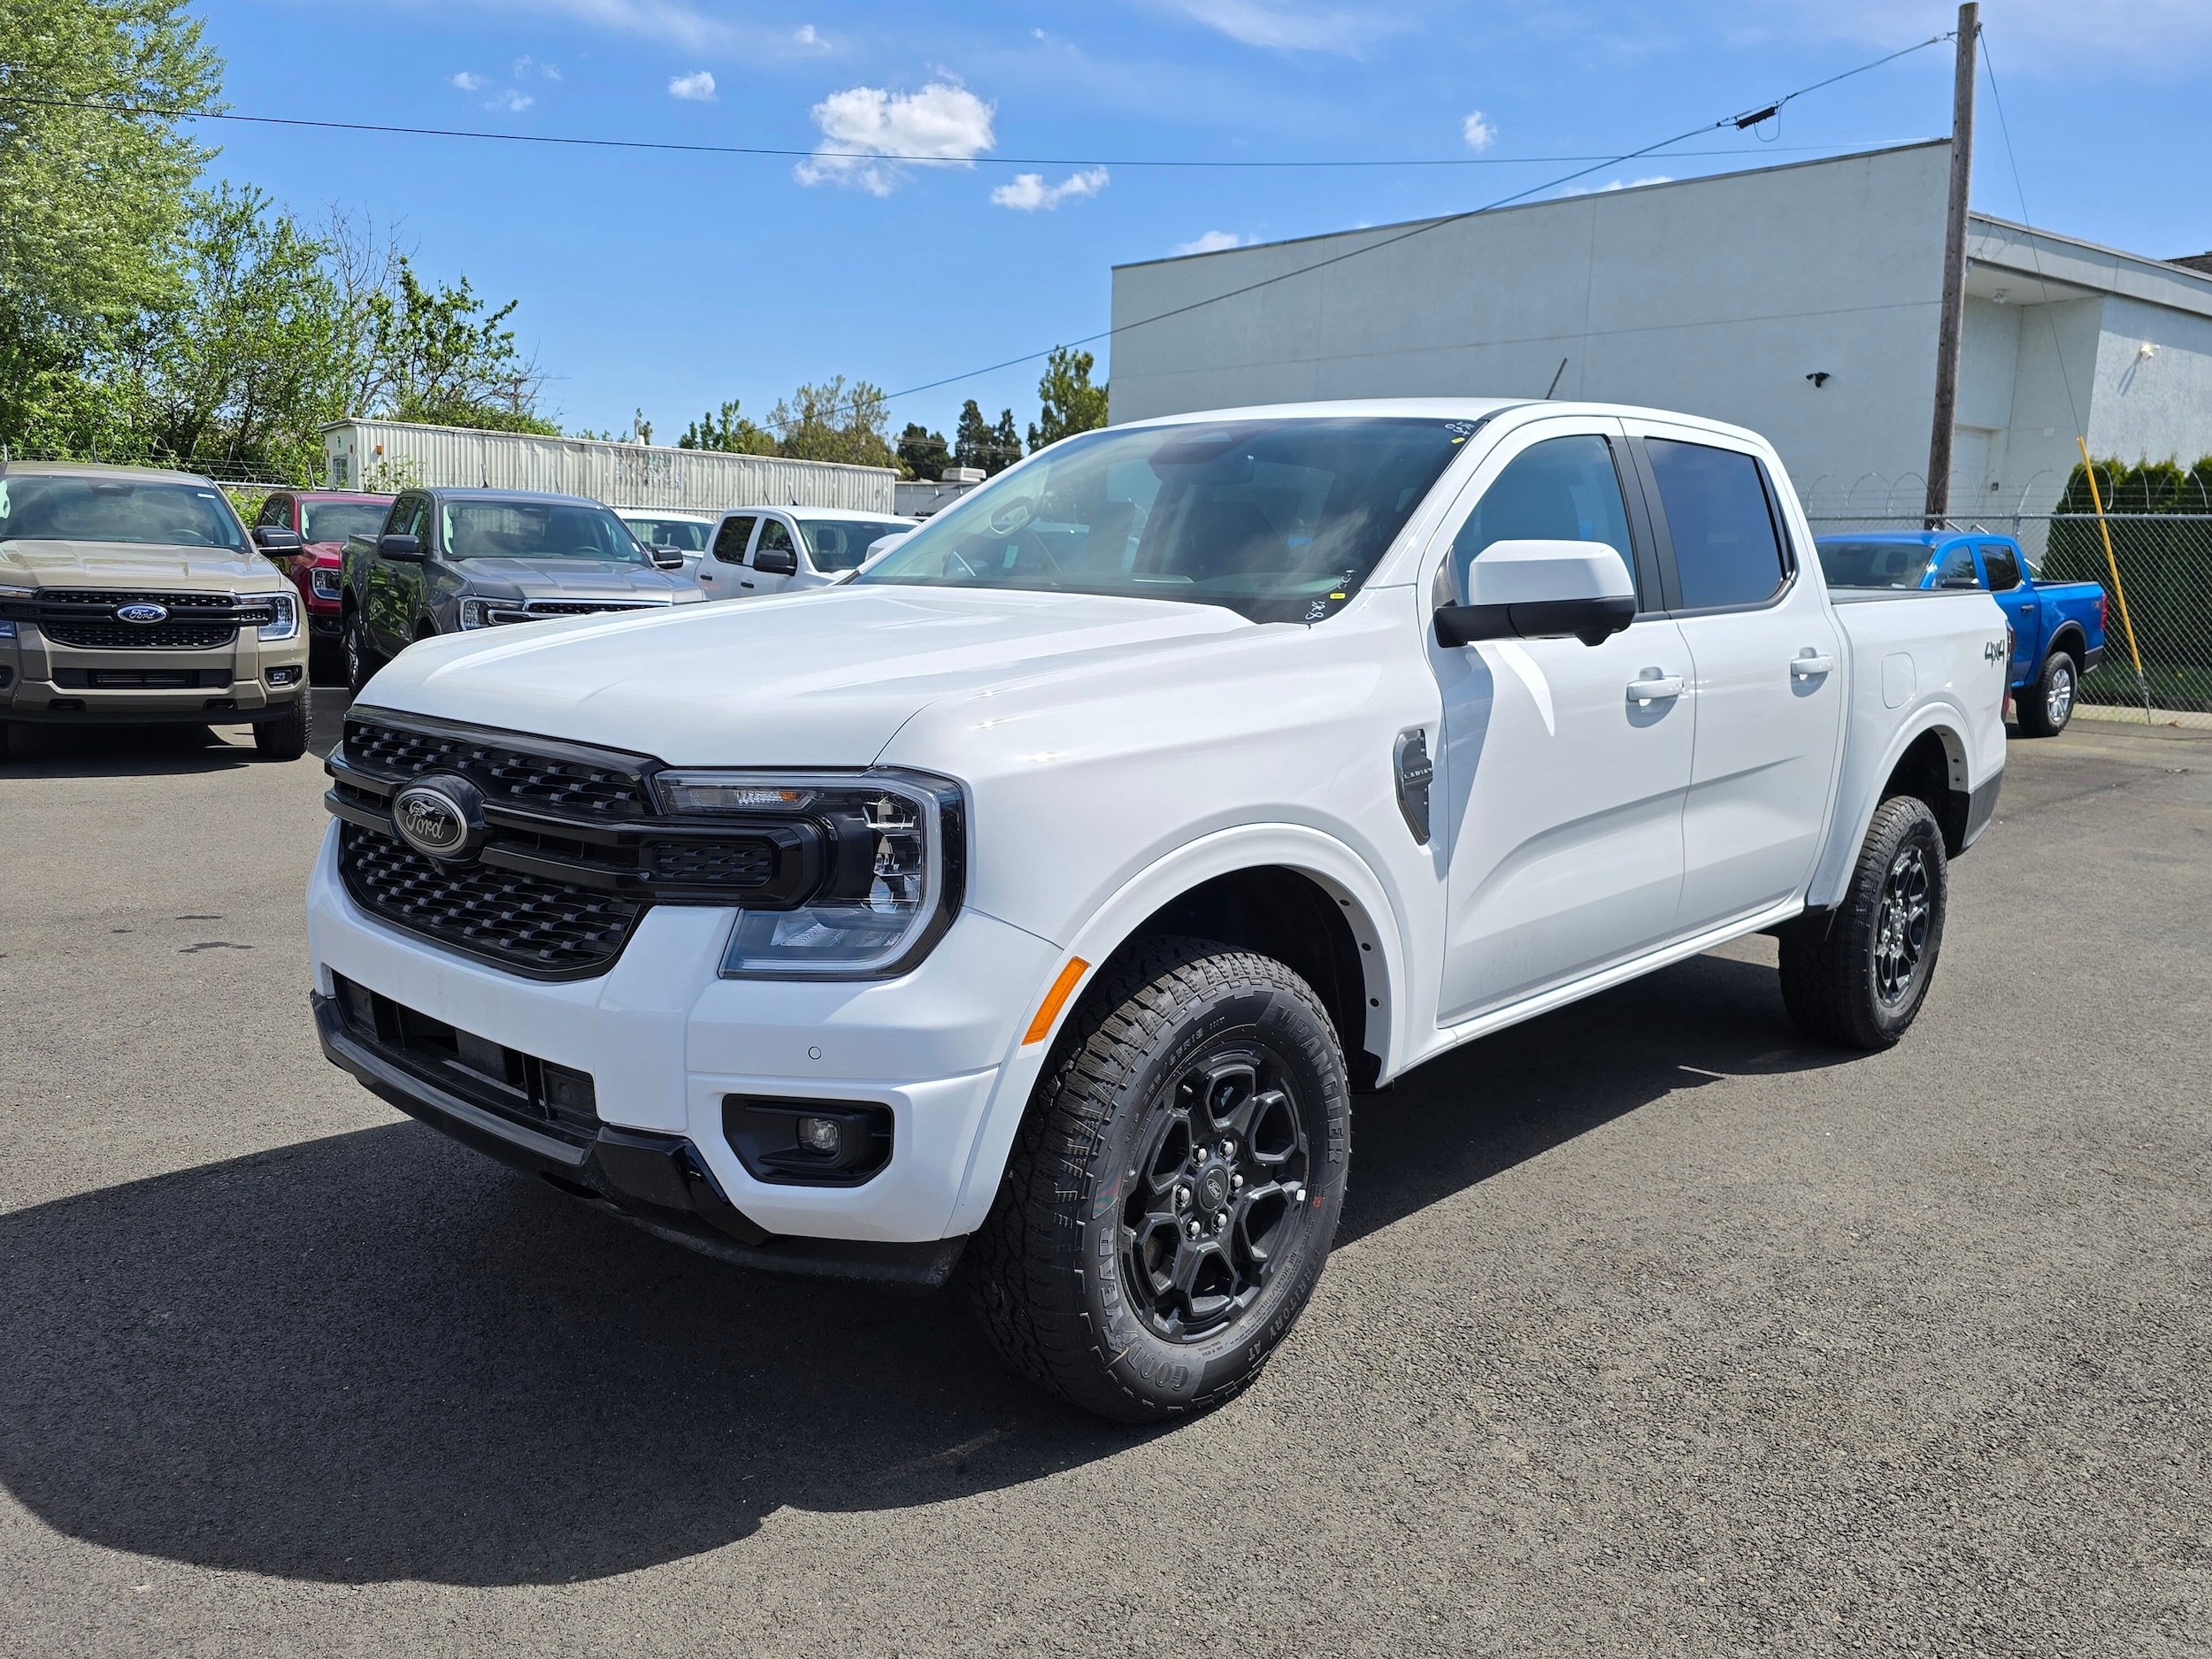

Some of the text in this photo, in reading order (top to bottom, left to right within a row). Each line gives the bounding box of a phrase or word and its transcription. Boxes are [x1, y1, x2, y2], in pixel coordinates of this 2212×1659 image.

[129, 609, 155, 618] Ford
[405, 800, 447, 839] Ford
[1273, 1005, 1345, 1164] WRANGLER
[1270, 1248, 1321, 1340] TERRITORY
[1248, 1340, 1262, 1362] AT
